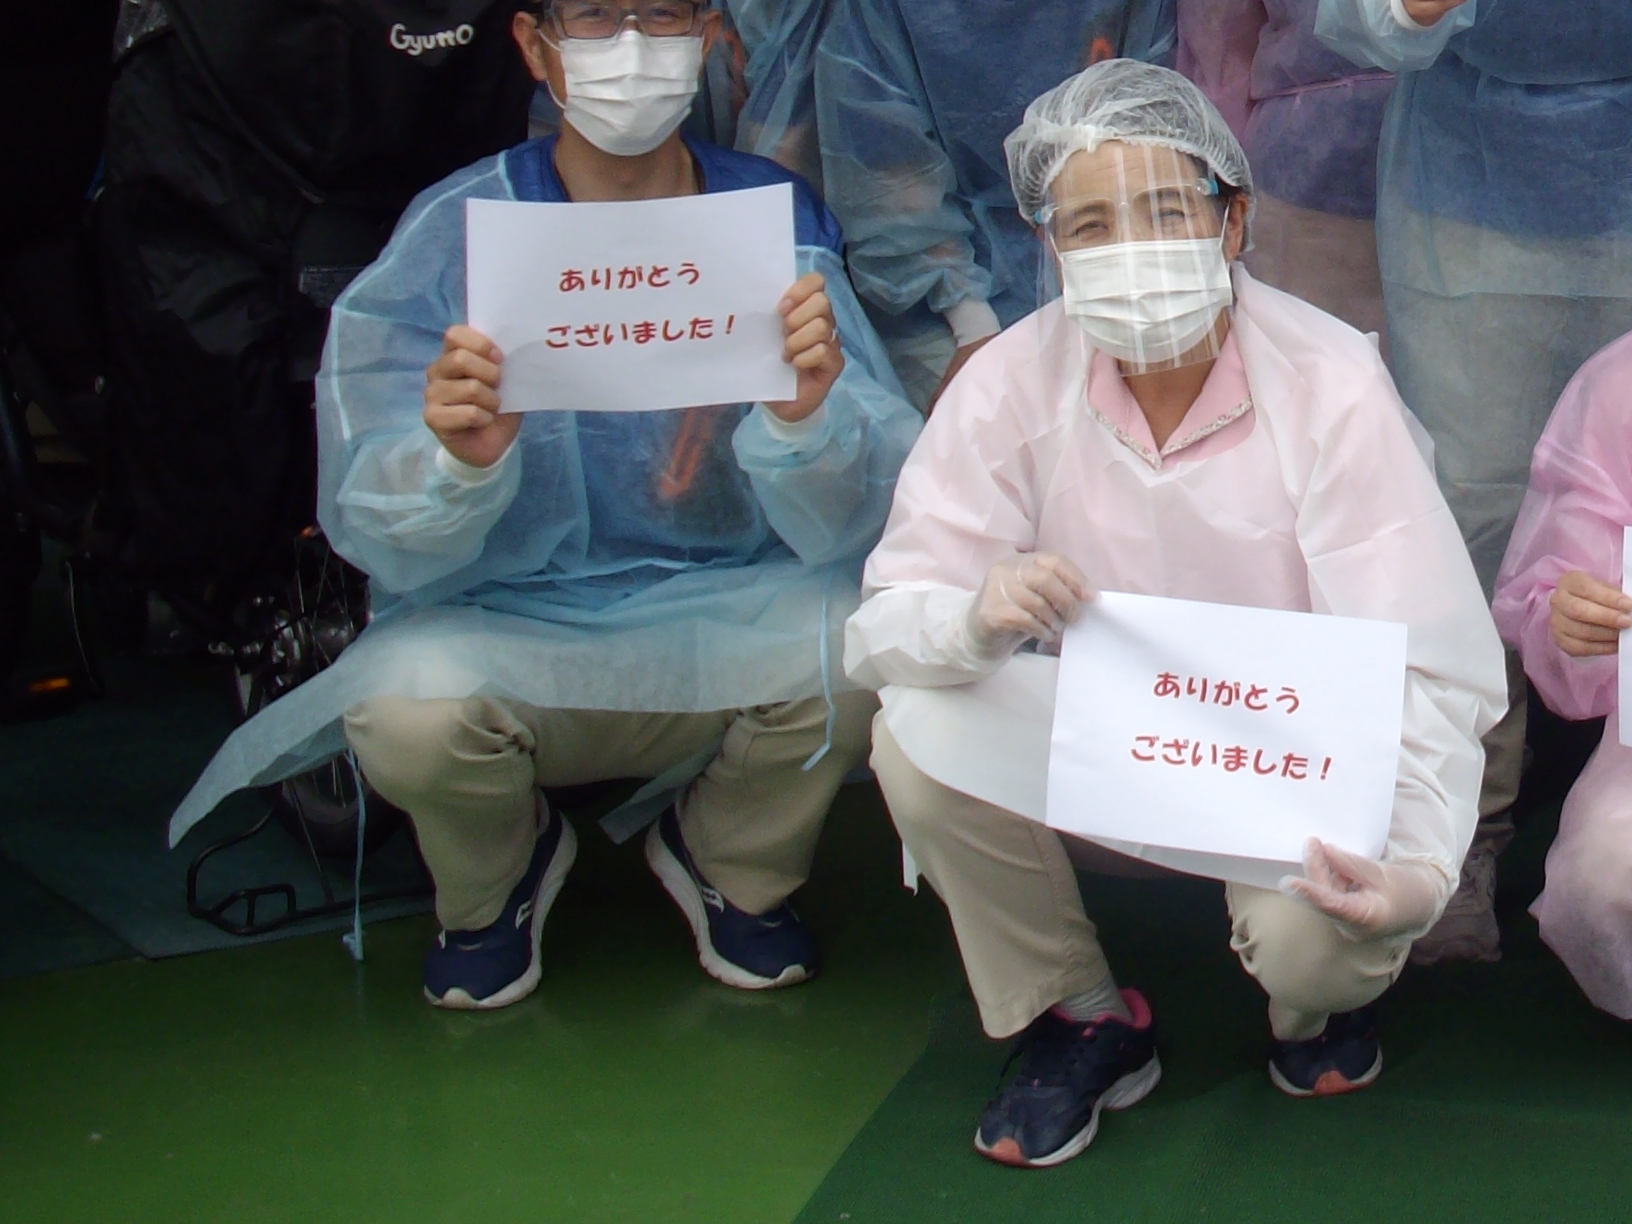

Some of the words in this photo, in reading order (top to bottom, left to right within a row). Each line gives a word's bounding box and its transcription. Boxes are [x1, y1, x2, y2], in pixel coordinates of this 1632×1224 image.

[560, 262, 700, 292] ありがとう
[1153, 672, 1300, 714] ありがとう
